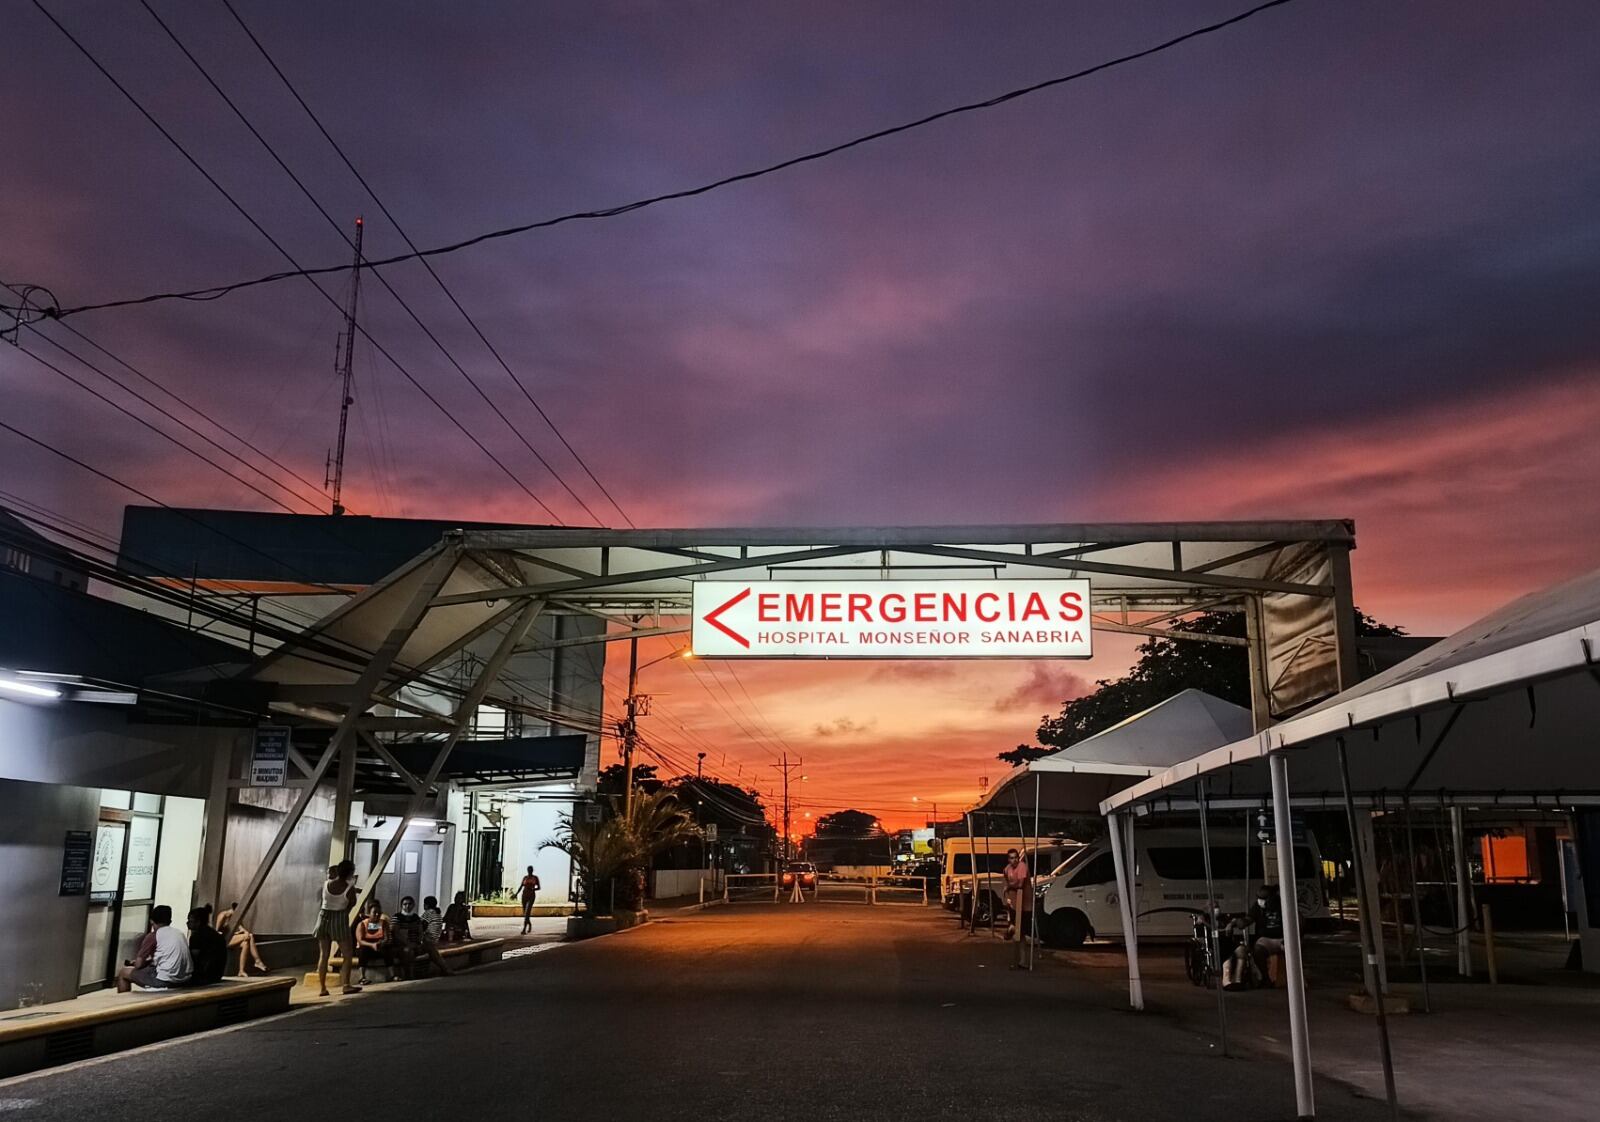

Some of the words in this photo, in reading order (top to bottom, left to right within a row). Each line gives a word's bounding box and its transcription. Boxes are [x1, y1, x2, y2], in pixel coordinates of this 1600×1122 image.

[758, 592, 1084, 623] EMERGENCIAS
[758, 631, 850, 645] HOSPITAL
[859, 629, 970, 644] MONSEÑOR
[980, 630, 1084, 643] SANABRIA
